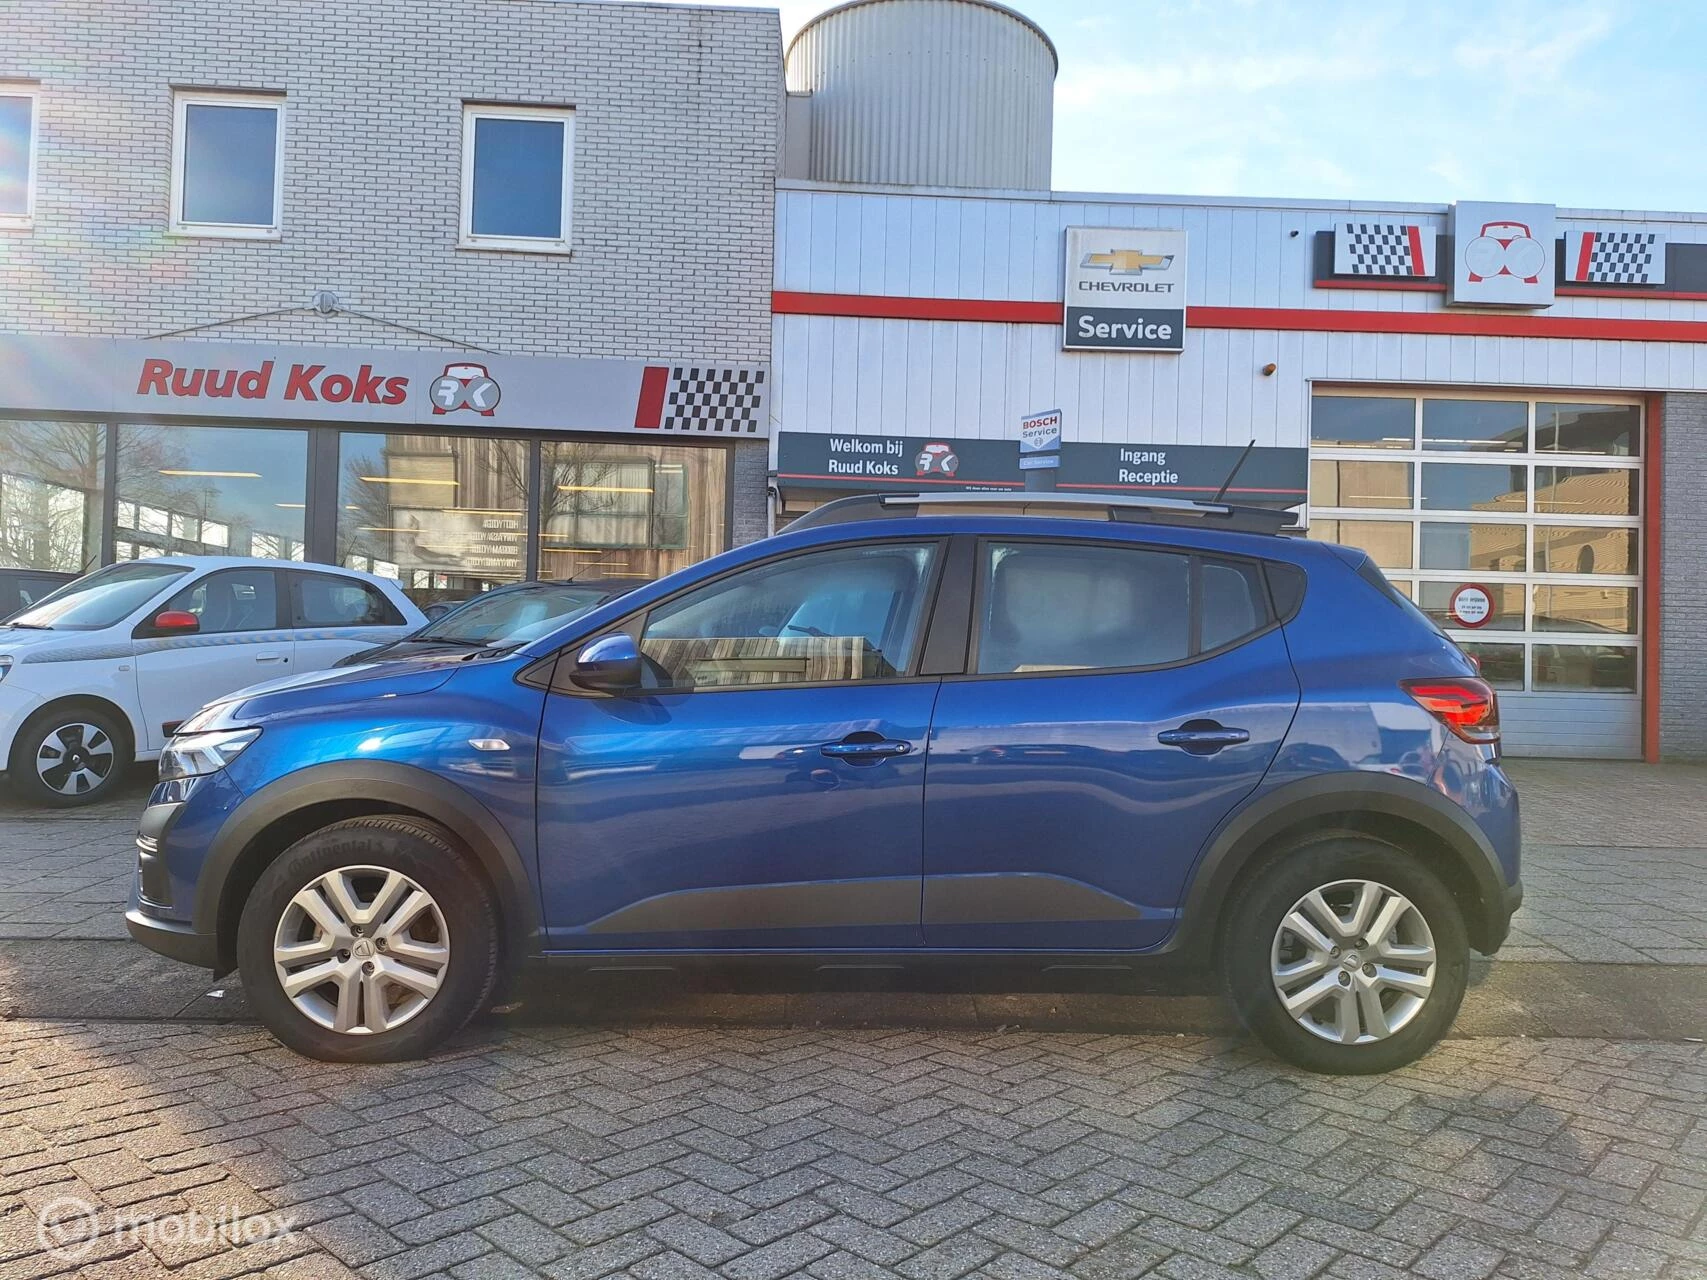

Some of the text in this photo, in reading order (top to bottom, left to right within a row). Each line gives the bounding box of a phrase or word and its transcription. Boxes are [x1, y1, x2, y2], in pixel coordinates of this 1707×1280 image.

[1078, 281, 1175, 293] CHEVROLET
[1078, 315, 1172, 340] Service
[136, 358, 410, 405] Ruud Koks
[1022, 416, 1058, 430] BOSCH
[1022, 427, 1058, 438] Service
[829, 438, 904, 457] Welkom bij
[1120, 448, 1166, 465] Ingang
[828, 459, 899, 475] Ruud Koks
[1119, 468, 1178, 486] Receptie
